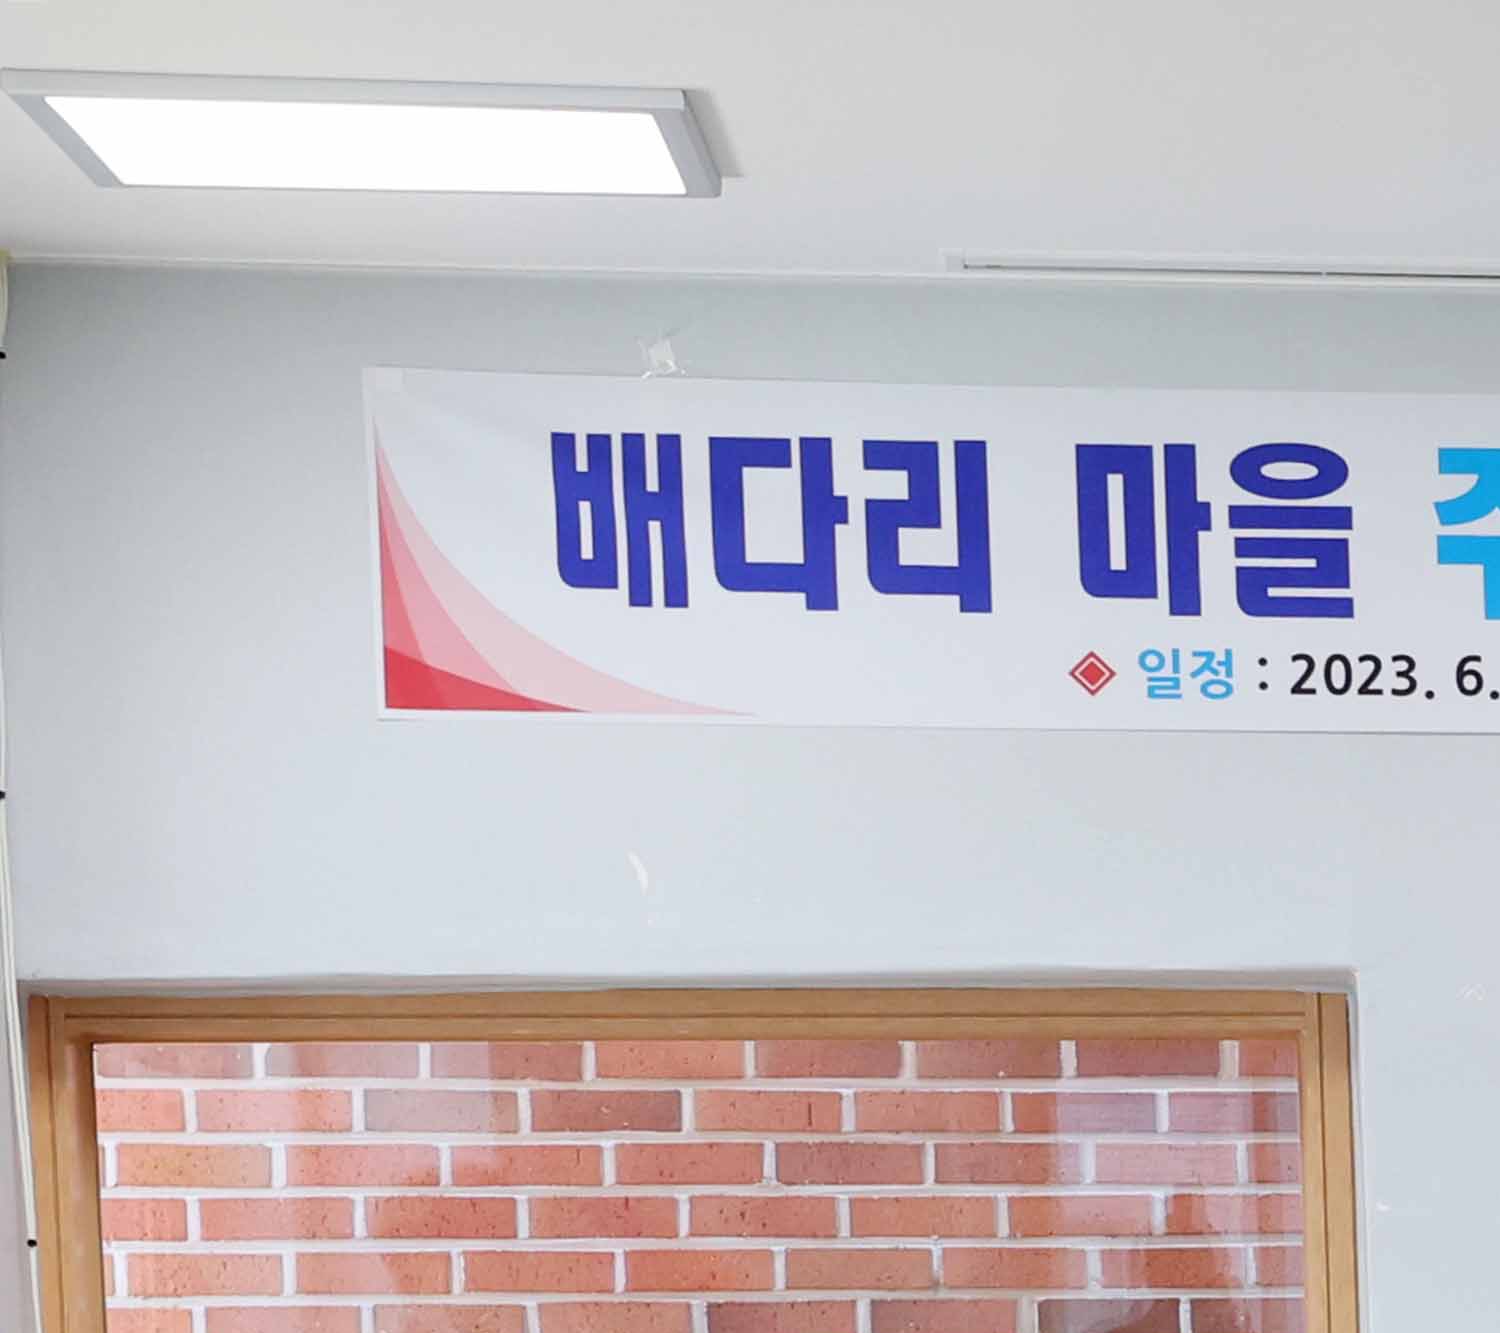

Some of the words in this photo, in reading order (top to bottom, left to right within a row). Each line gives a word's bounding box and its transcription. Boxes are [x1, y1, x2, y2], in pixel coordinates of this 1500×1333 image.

[550, 431, 993, 614] 배다리
[1075, 442, 1354, 619] 마을
[1138, 648, 1234, 700] 일정
[1290, 653, 1435, 700] 2023.
[1455, 654, 1500, 701] 6.
